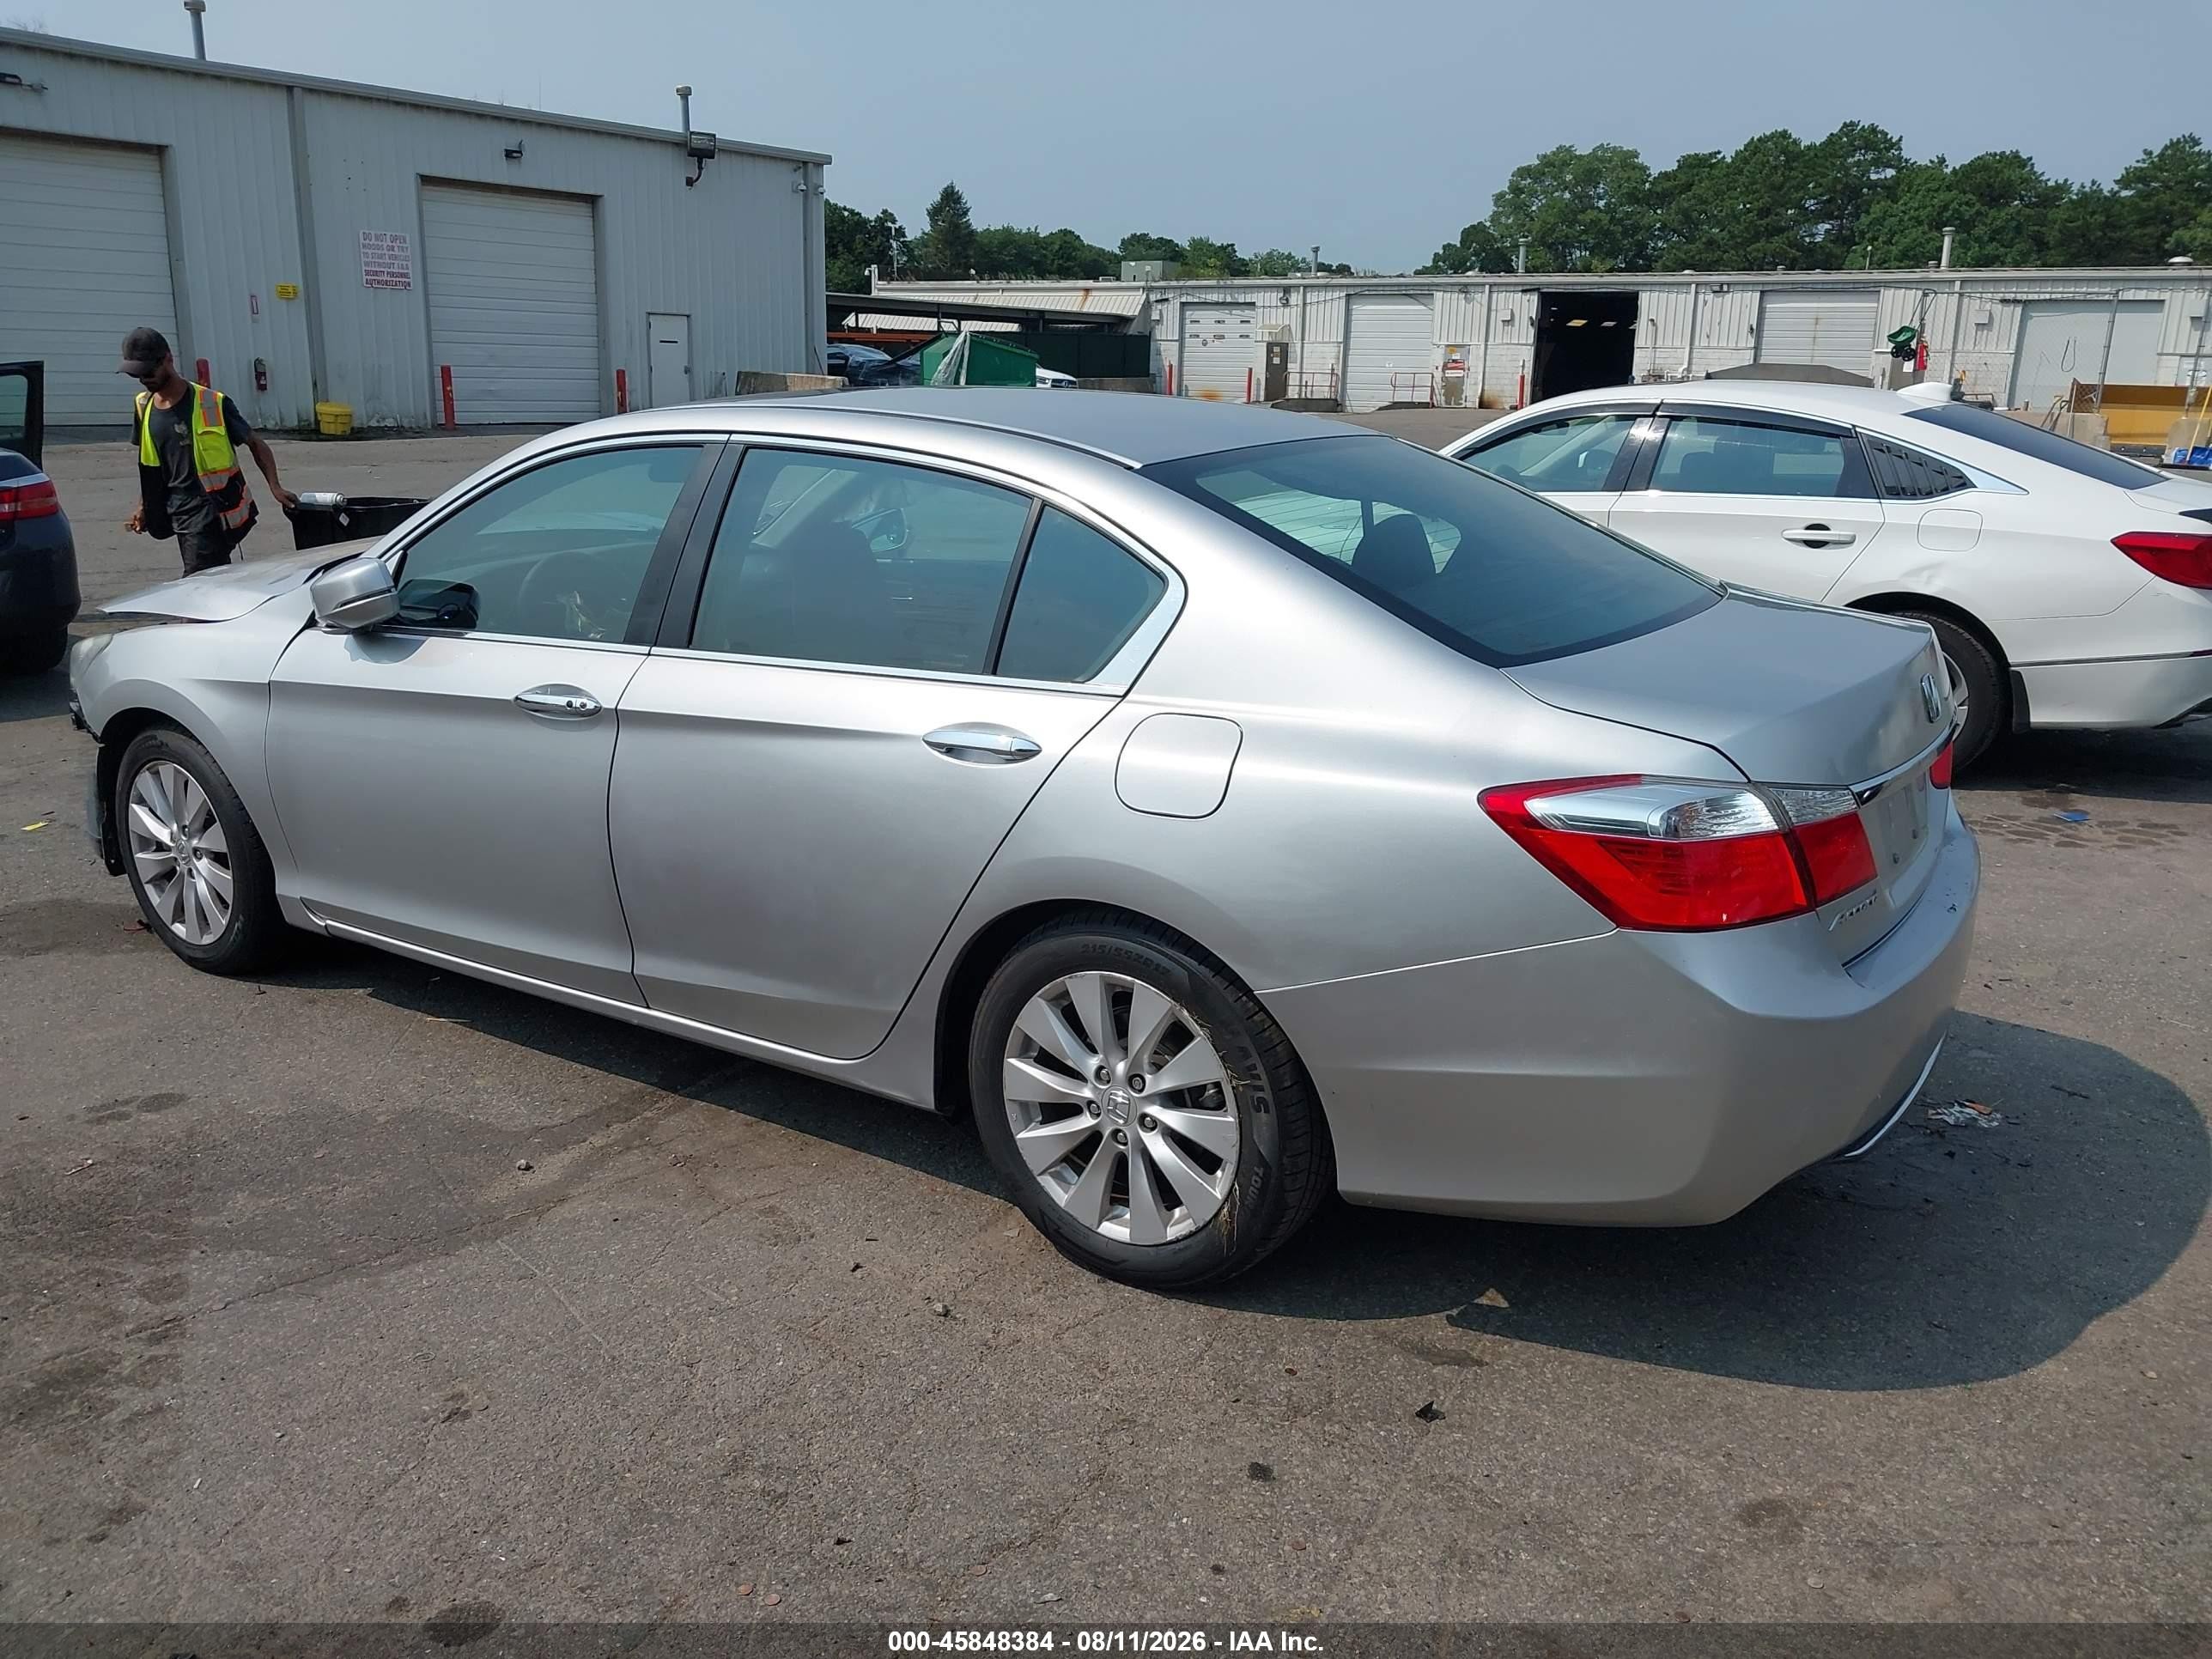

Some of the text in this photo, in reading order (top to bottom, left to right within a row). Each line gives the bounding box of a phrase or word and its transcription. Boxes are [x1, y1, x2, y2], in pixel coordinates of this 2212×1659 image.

[362, 232, 407, 244] DO NOT OPEN
[386, 244, 395, 252] OR
[371, 252, 386, 260] START
[363, 260, 395, 269] WITHOUT
[386, 270, 410, 279] PERSONNEL
[365, 278, 411, 288] AUTHORIZATION
